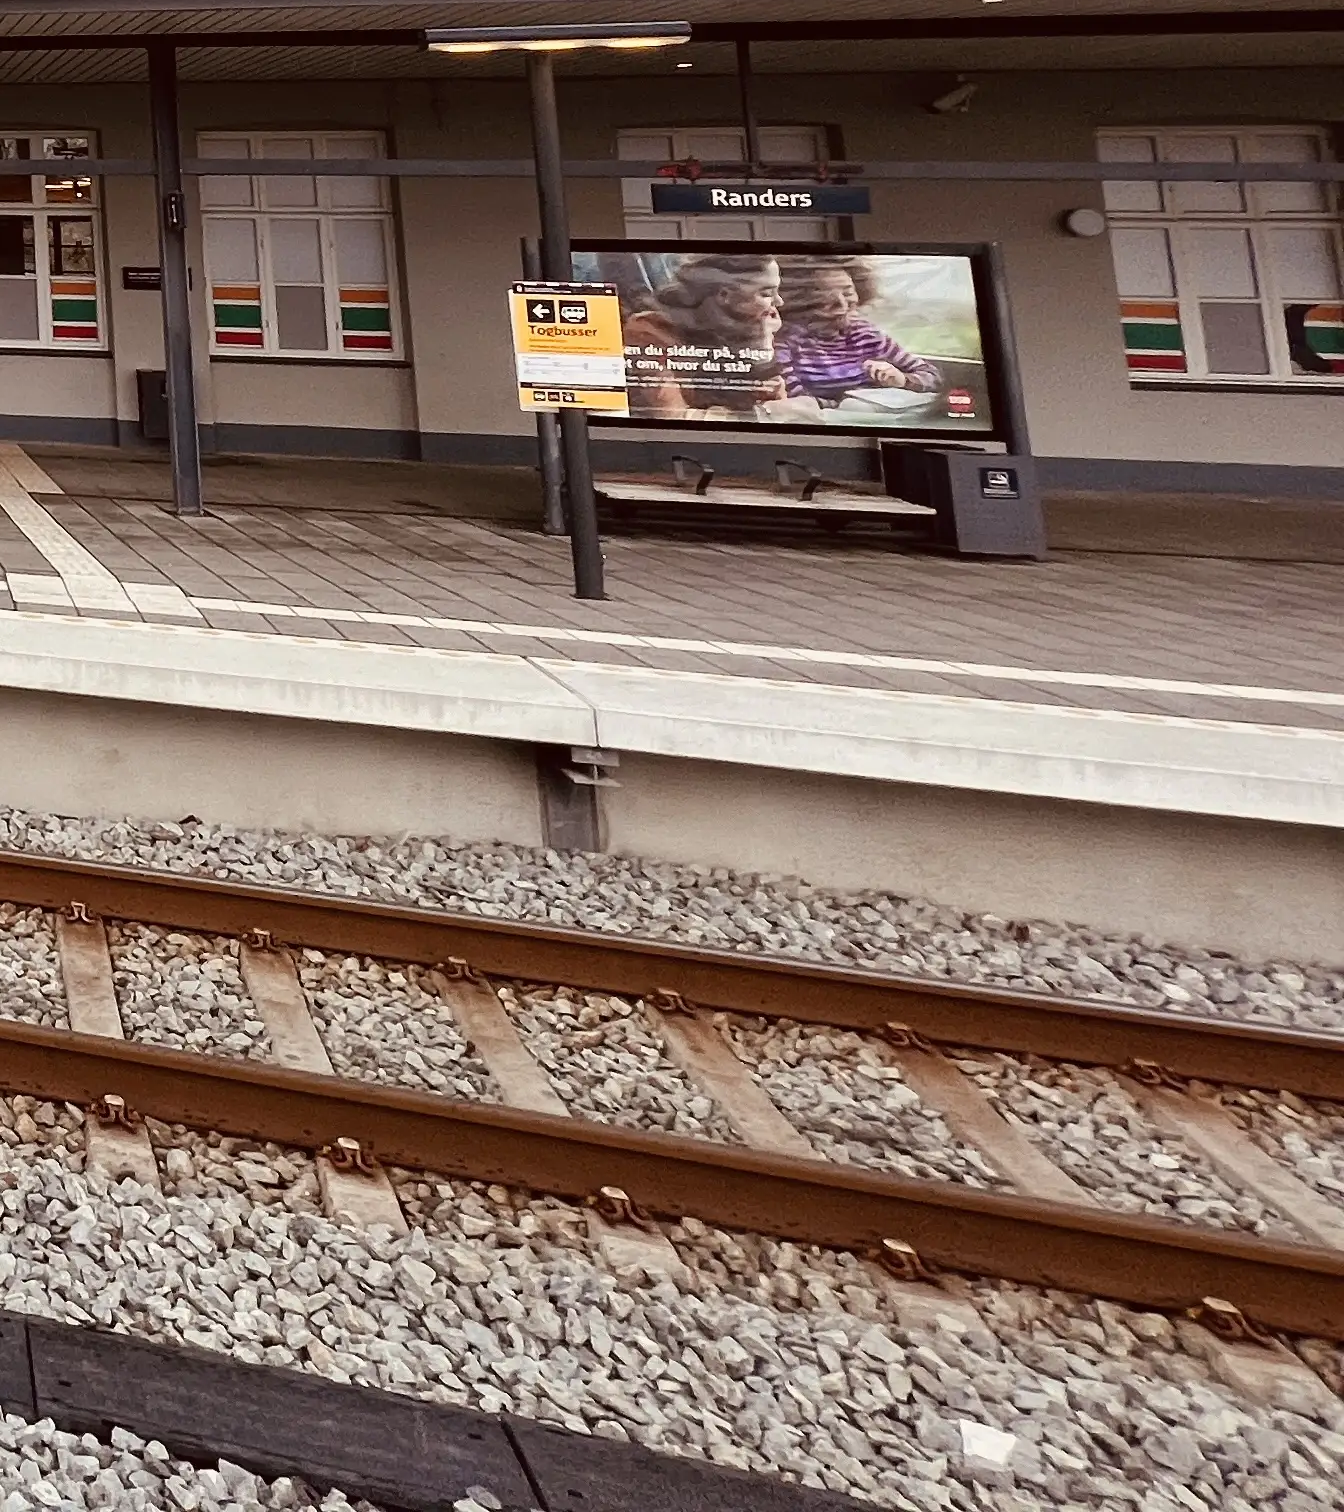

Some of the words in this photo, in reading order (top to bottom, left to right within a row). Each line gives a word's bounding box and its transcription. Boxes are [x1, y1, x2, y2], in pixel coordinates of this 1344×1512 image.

[711, 188, 812, 207] Randers
[528, 324, 598, 338] Togbusser
[624, 346, 641, 356] en
[645, 344, 663, 356] du
[667, 345, 710, 357] sidder
[637, 360, 663, 371] om,
[667, 359, 699, 371] hvor
[702, 361, 721, 372] du
